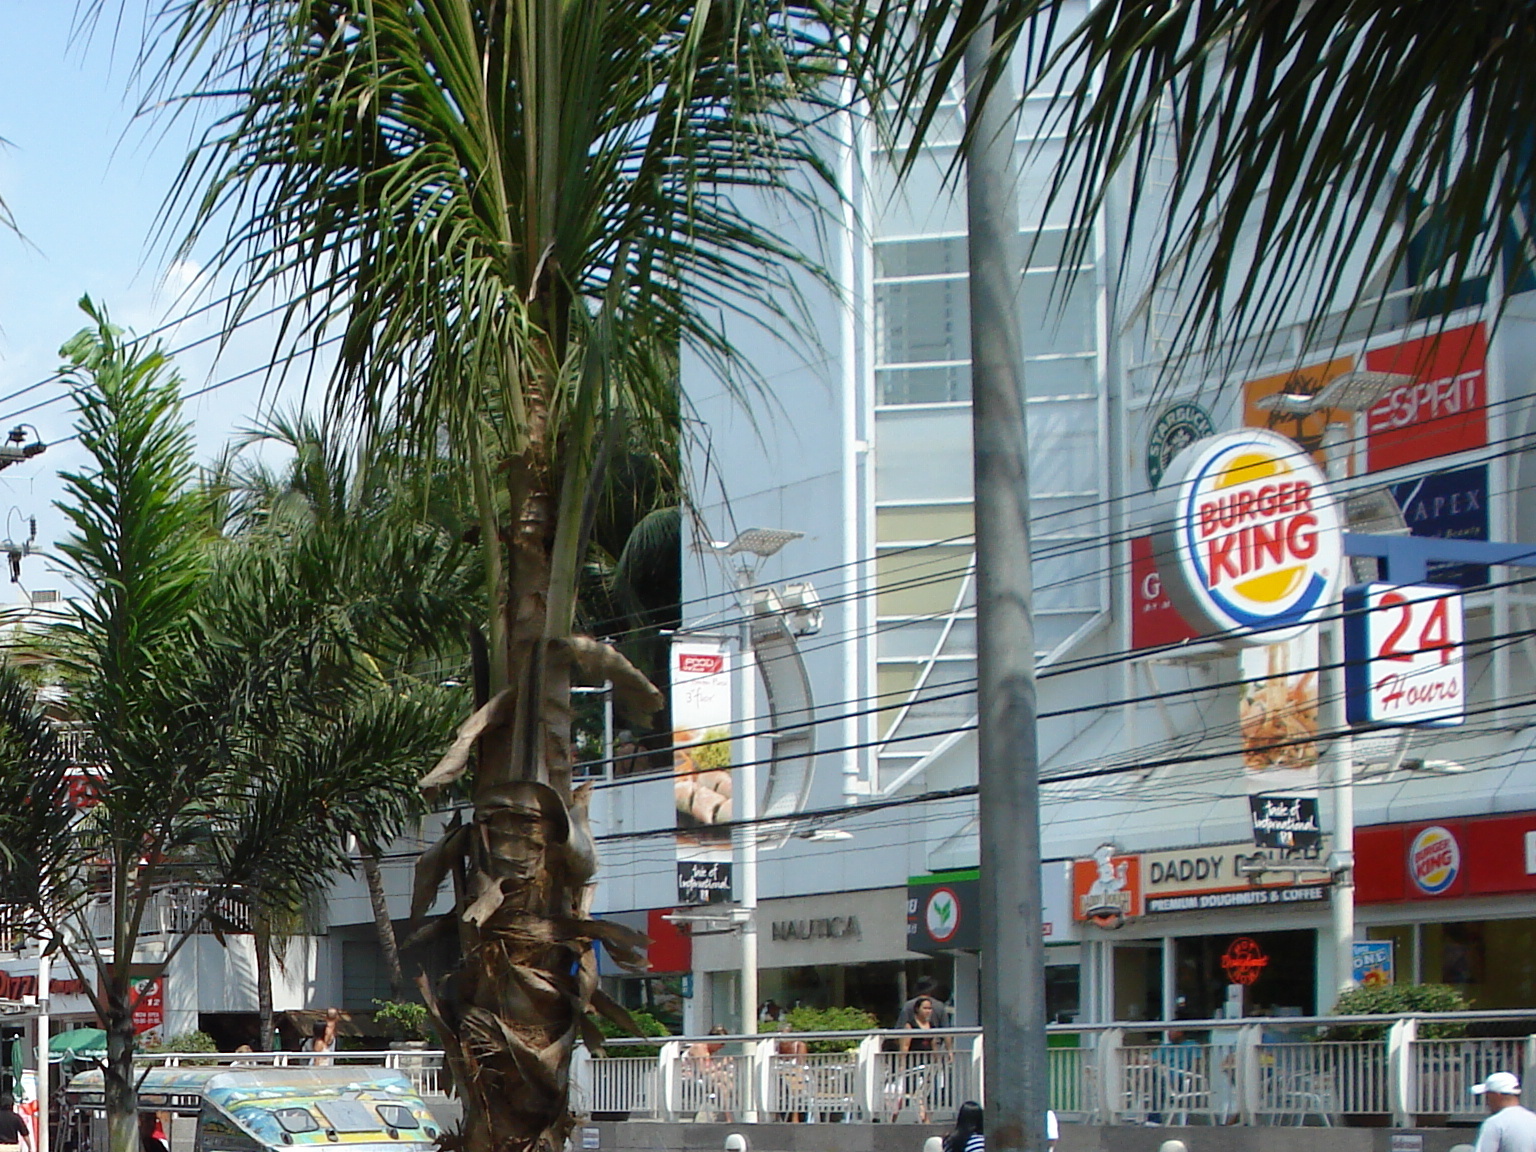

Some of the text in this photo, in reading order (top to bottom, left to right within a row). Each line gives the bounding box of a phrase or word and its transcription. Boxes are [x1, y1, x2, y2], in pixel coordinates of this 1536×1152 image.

[1371, 369, 1482, 431] ESPRIT
[1199, 480, 1314, 538] BURGER
[1415, 489, 1481, 521] APEX
[1208, 514, 1319, 591] KING
[1378, 592, 1456, 665] 24
[1375, 673, 1460, 712] Hours
[1151, 855, 1223, 885] DADDY
[1417, 850, 1453, 877] KING
[1151, 887, 1324, 911] PREMIUM DOUGHNUTS & COFFEE
[771, 914, 863, 943] NAUTICA
